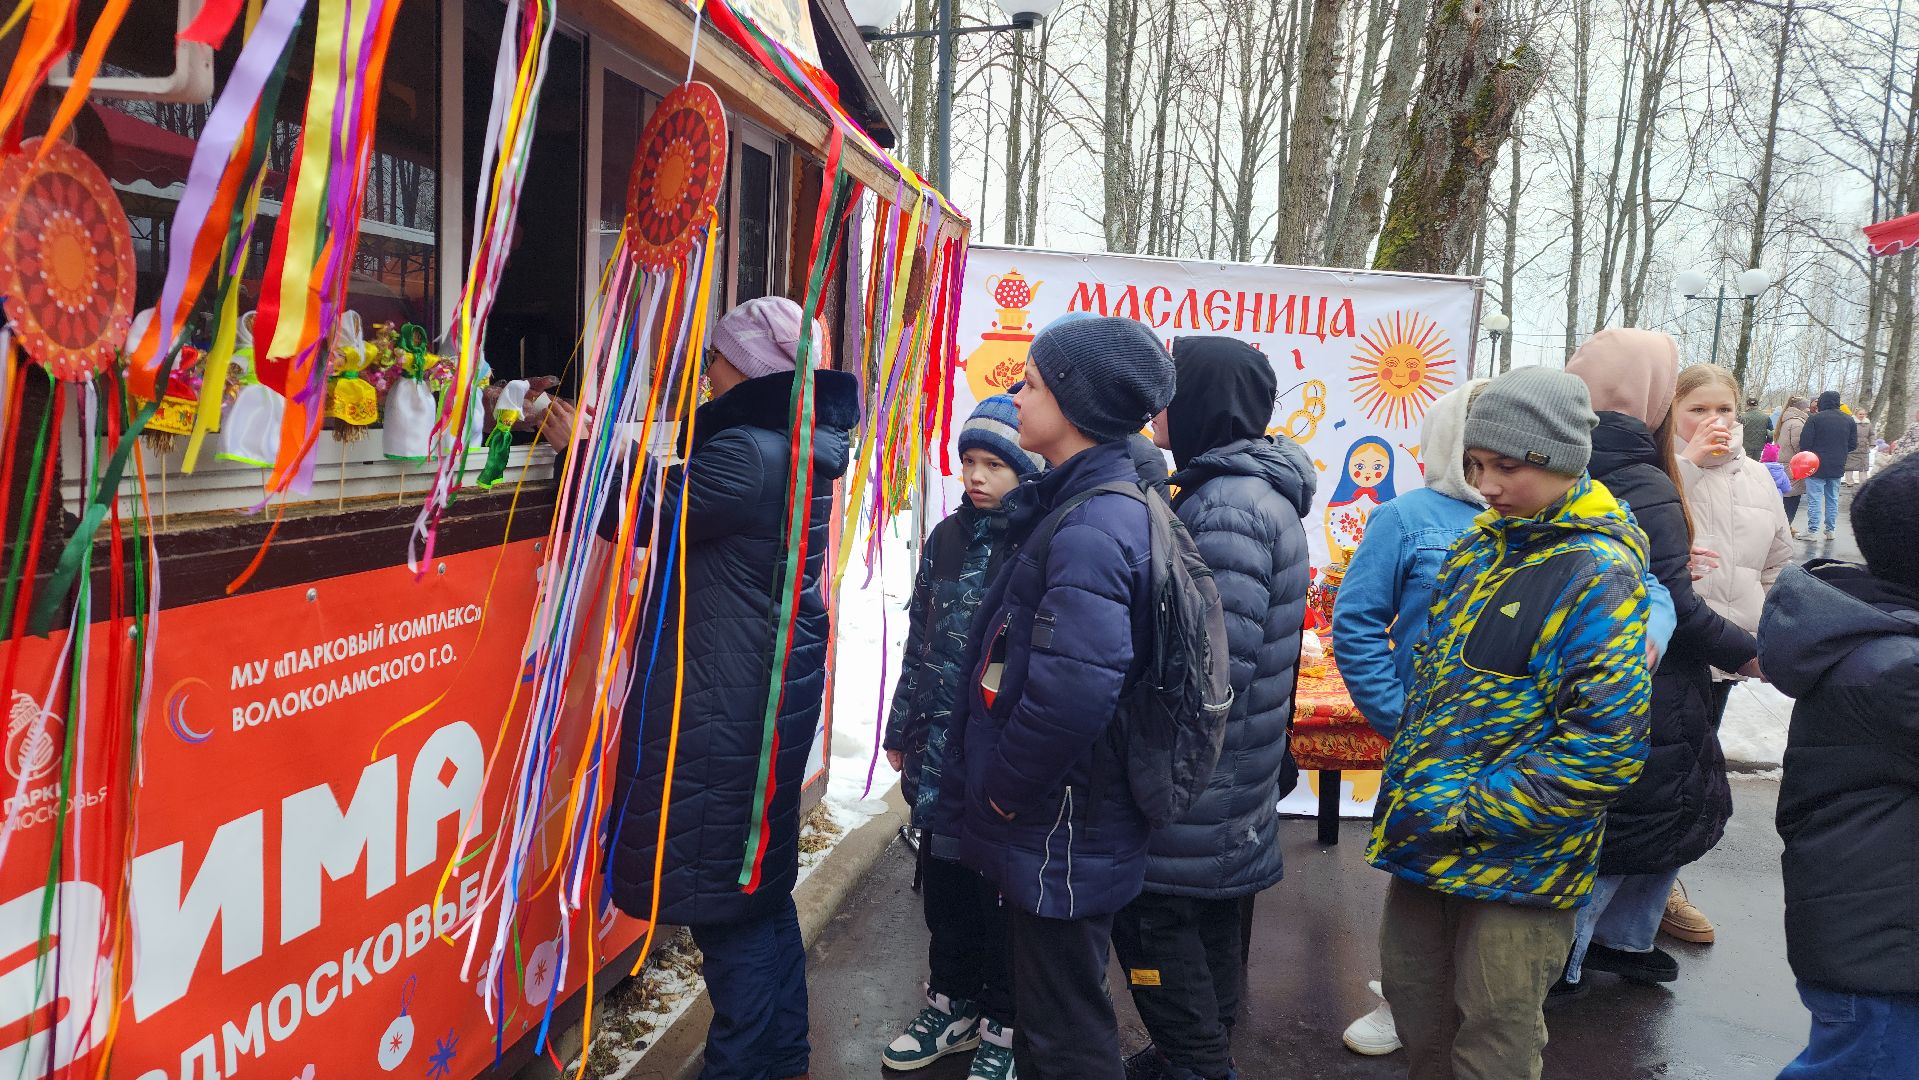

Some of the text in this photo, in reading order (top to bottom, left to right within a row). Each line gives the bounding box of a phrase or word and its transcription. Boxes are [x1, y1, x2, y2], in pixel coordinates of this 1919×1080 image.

[1067, 281, 1356, 344] МАСЛЕНИЦА
[230, 603, 482, 690] МУ «ПАРКОВЫЙ КОМПЛЕКС»
[231, 643, 458, 732] ВОЛОКОЛАМСКОГО Г.О.
[136, 870, 480, 1080] ДМОСКОВЬЕ
